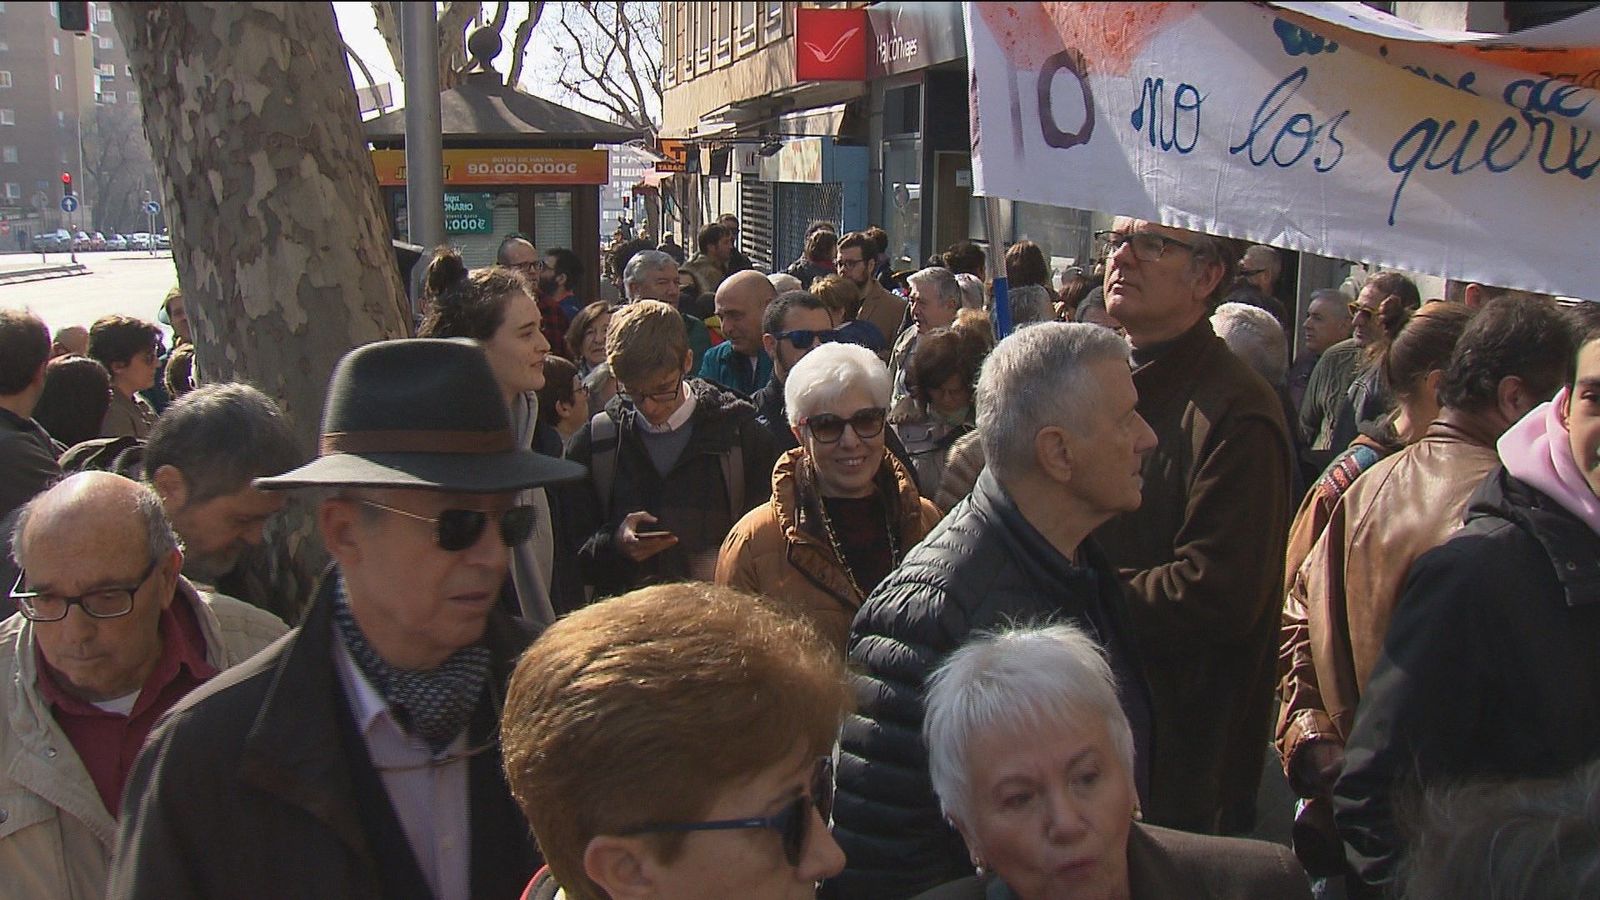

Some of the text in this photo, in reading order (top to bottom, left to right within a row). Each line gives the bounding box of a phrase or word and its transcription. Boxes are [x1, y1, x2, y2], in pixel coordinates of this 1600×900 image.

[1131, 76, 1210, 154] no
[1229, 65, 1351, 172] los
[1386, 106, 1600, 226] quere
[468, 163, 577, 174] 90.000.000€
[658, 163, 684, 171] TABAC
